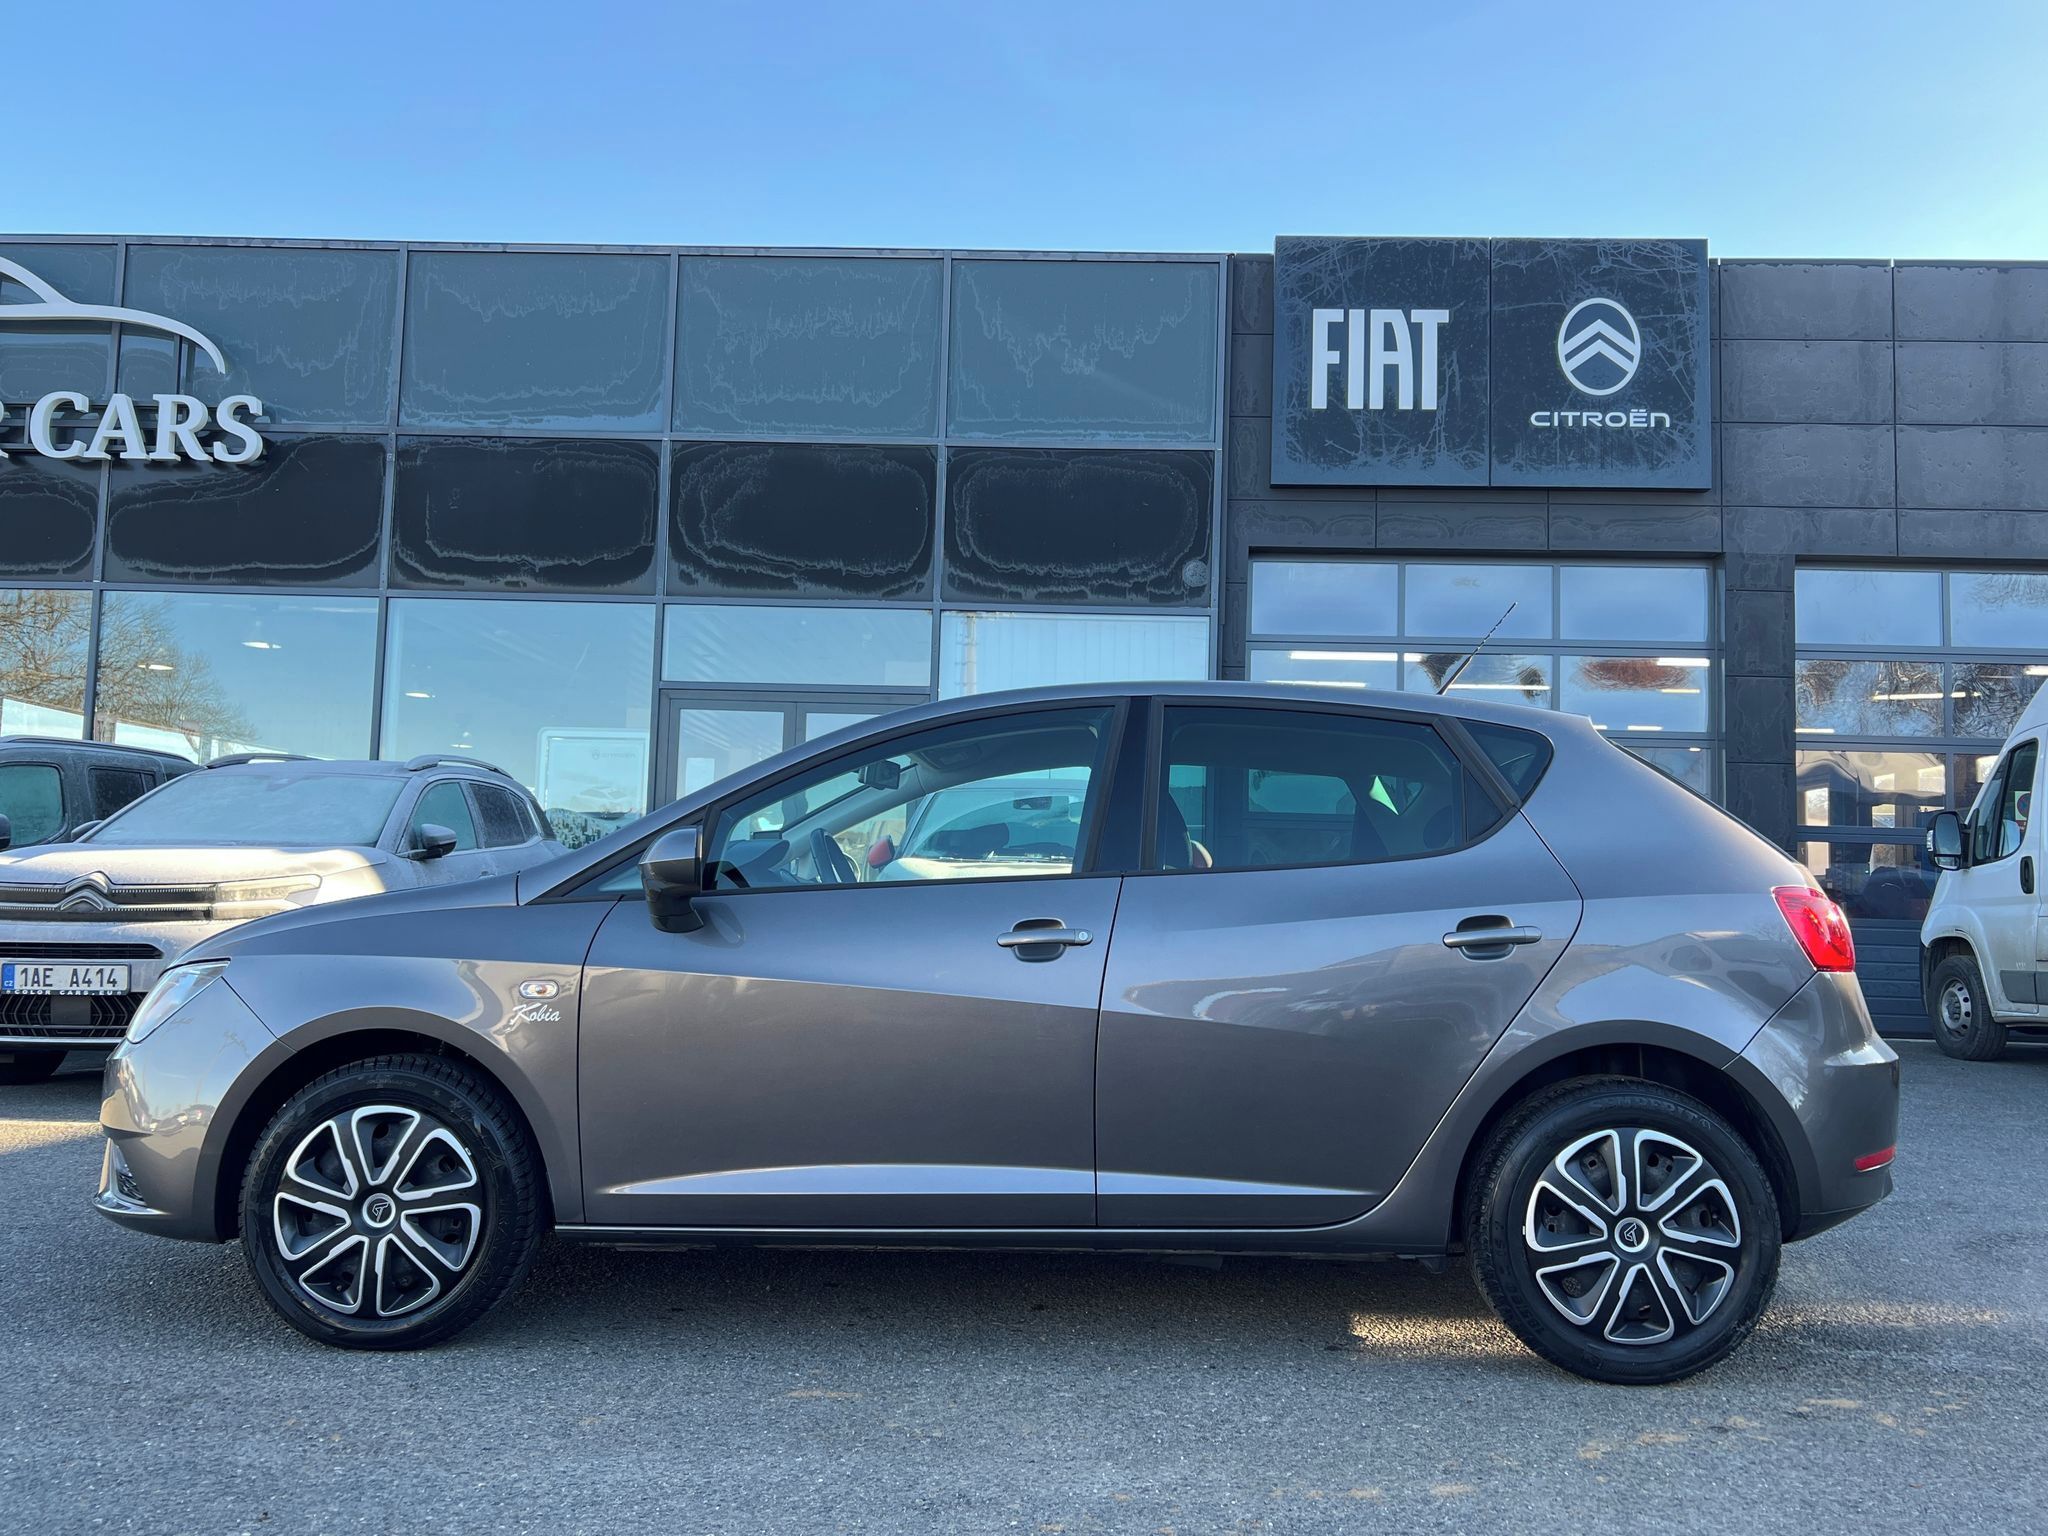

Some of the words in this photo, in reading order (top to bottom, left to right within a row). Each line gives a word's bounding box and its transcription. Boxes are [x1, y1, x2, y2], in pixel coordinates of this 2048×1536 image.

[1311, 308, 1450, 410] FIAT
[30, 391, 263, 463] CARS
[1530, 408, 1671, 428] CITROËN
[20, 967, 54, 988] 1AE
[69, 968, 118, 988] A414
[504, 1002, 561, 1032] Kobia
